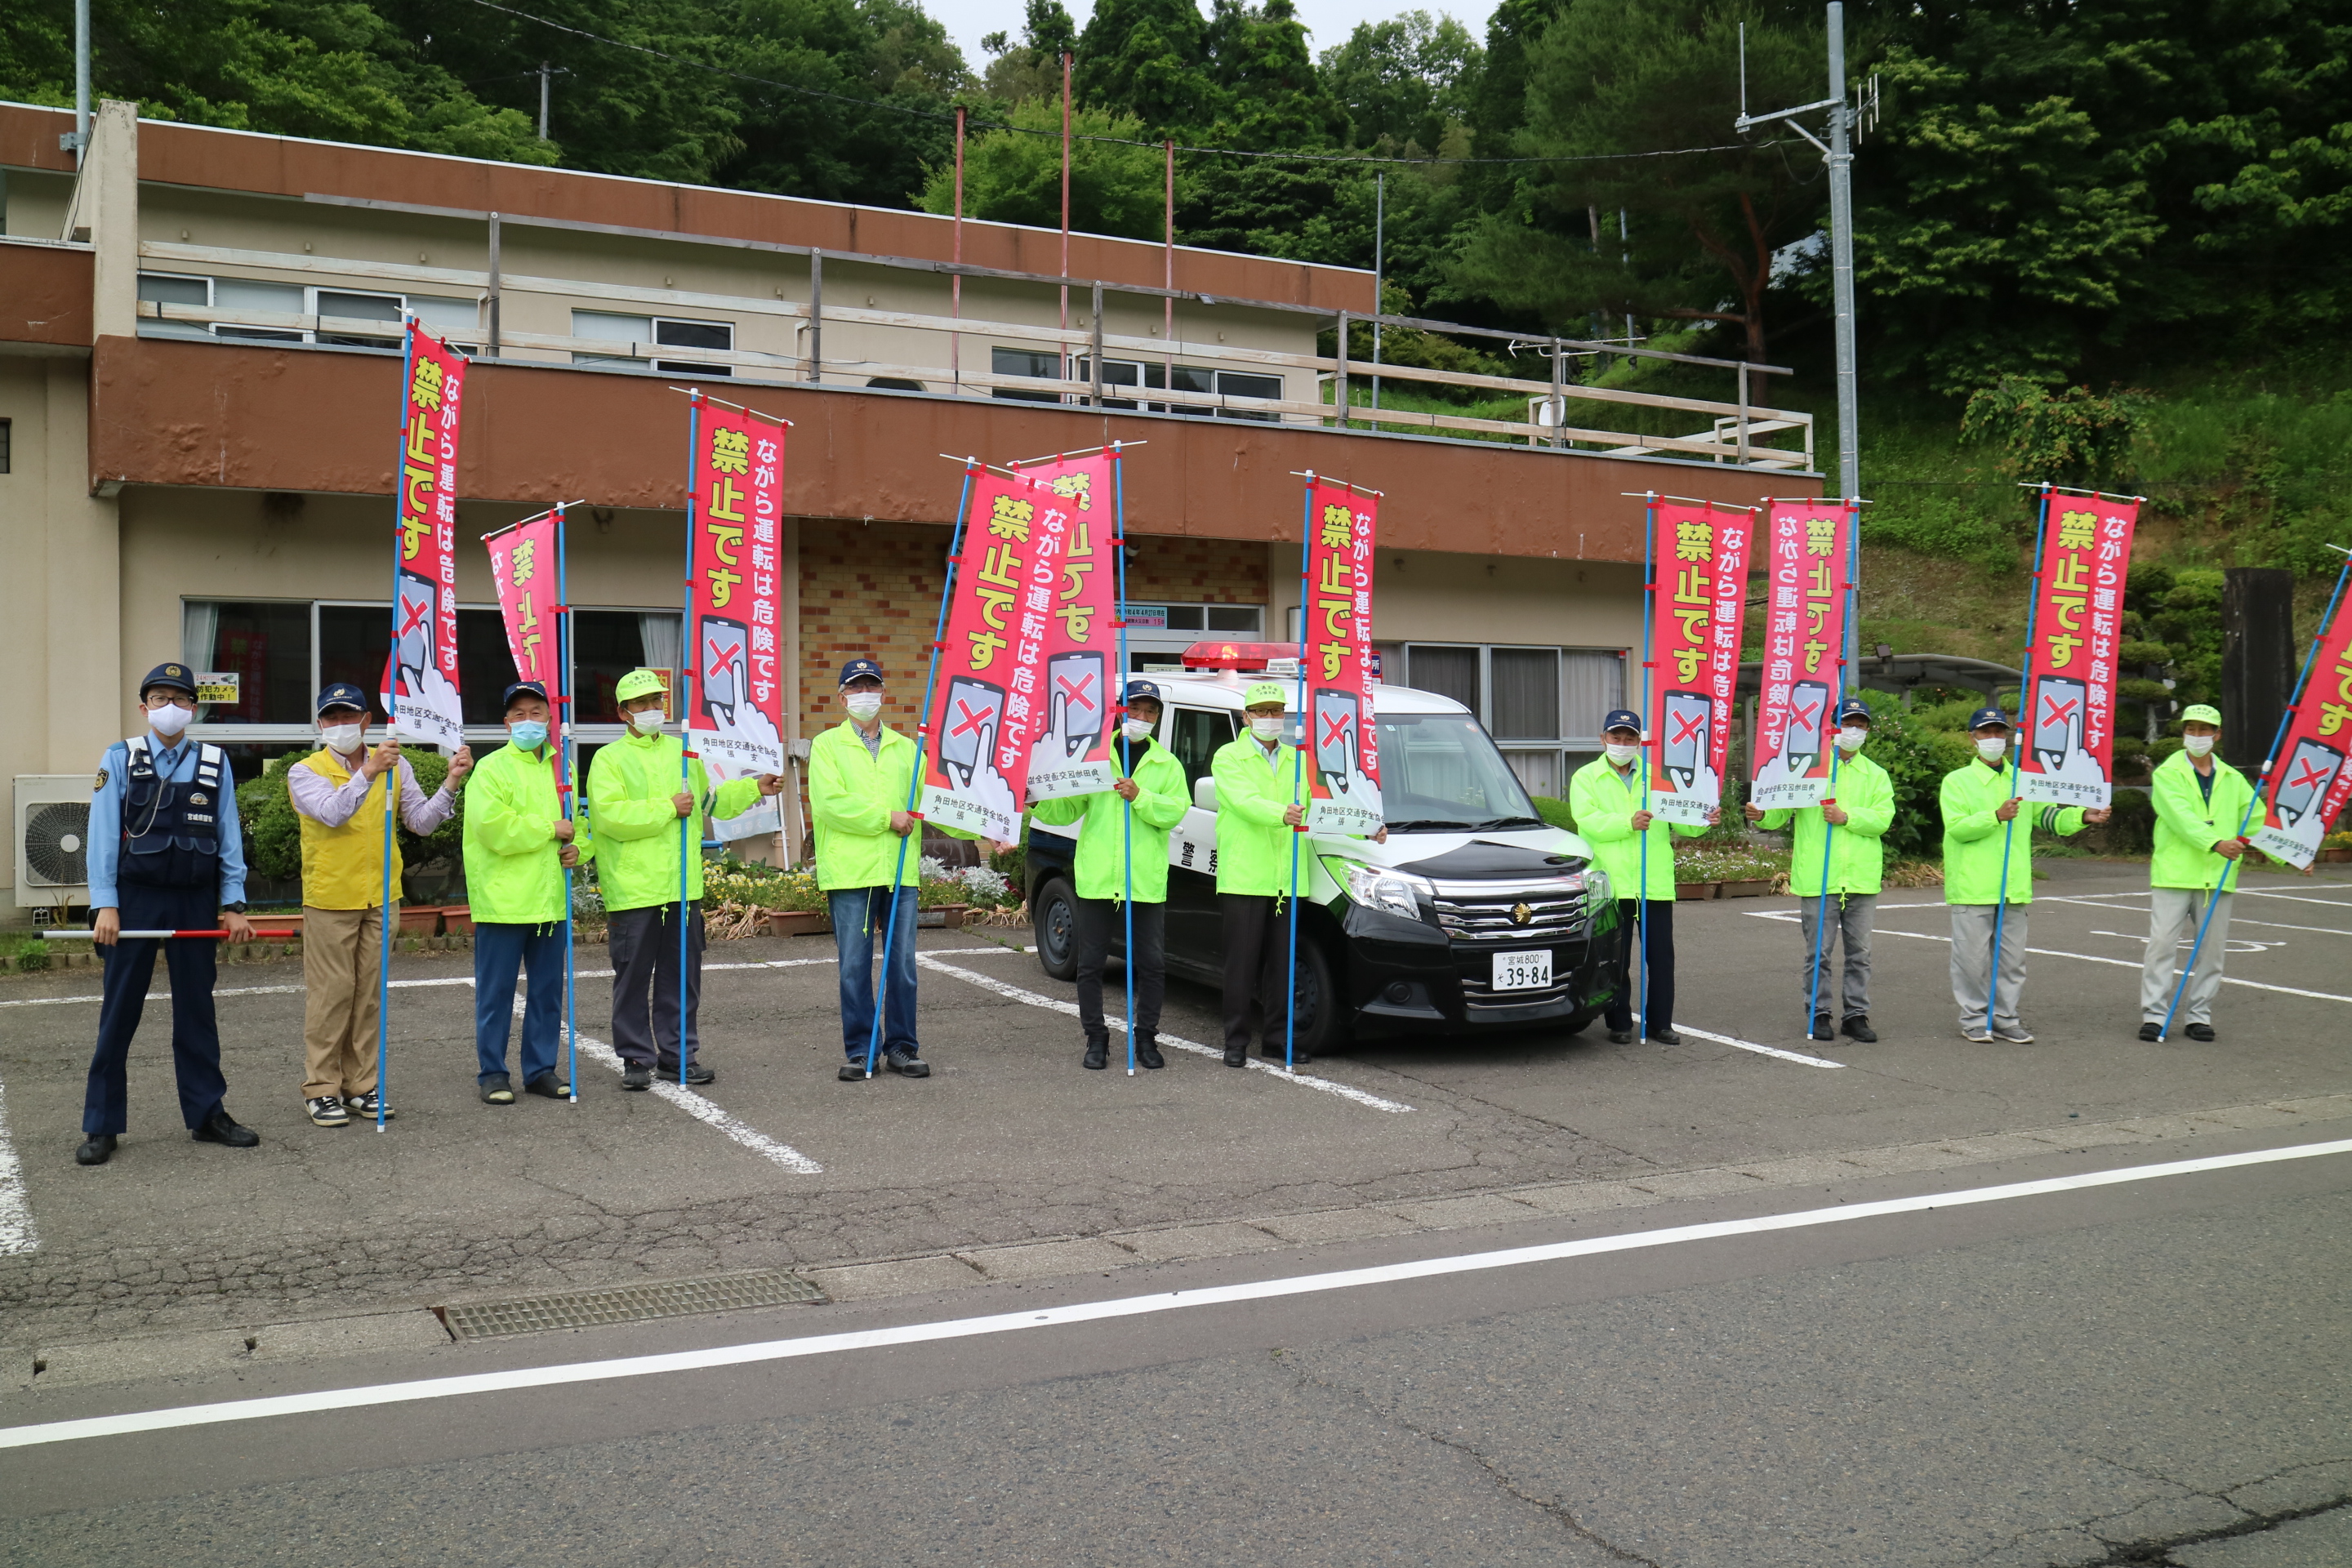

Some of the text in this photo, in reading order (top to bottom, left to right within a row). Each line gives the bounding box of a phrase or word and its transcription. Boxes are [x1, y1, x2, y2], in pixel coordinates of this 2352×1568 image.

[401, 356, 443, 560] 禁止です
[436, 374, 459, 670] ながら運転は危険です
[707, 426, 750, 609] 禁止です
[751, 438, 777, 703] ながら運転は危険です
[968, 494, 1035, 670] 禁止です
[1000, 507, 1067, 769] ながら運転は危険です
[1318, 504, 1354, 681] 禁止です
[1353, 512, 1378, 772] ながら運転は危険です
[1672, 519, 1714, 685] 禁止です
[2047, 510, 2098, 670] 禁止です
[2088, 516, 2127, 749] ながら運転は危険です
[702, 737, 777, 759] 角田地区交通安全協会
[2318, 639, 2352, 736] です
[932, 805, 1010, 835] 大張支部
[934, 794, 1011, 826] 角田地区交通安全協会
[2029, 788, 2102, 803] 大張支部
[2030, 778, 2102, 795] 角田地区交通安全協会
[1507, 965, 1549, 987] 39-84
